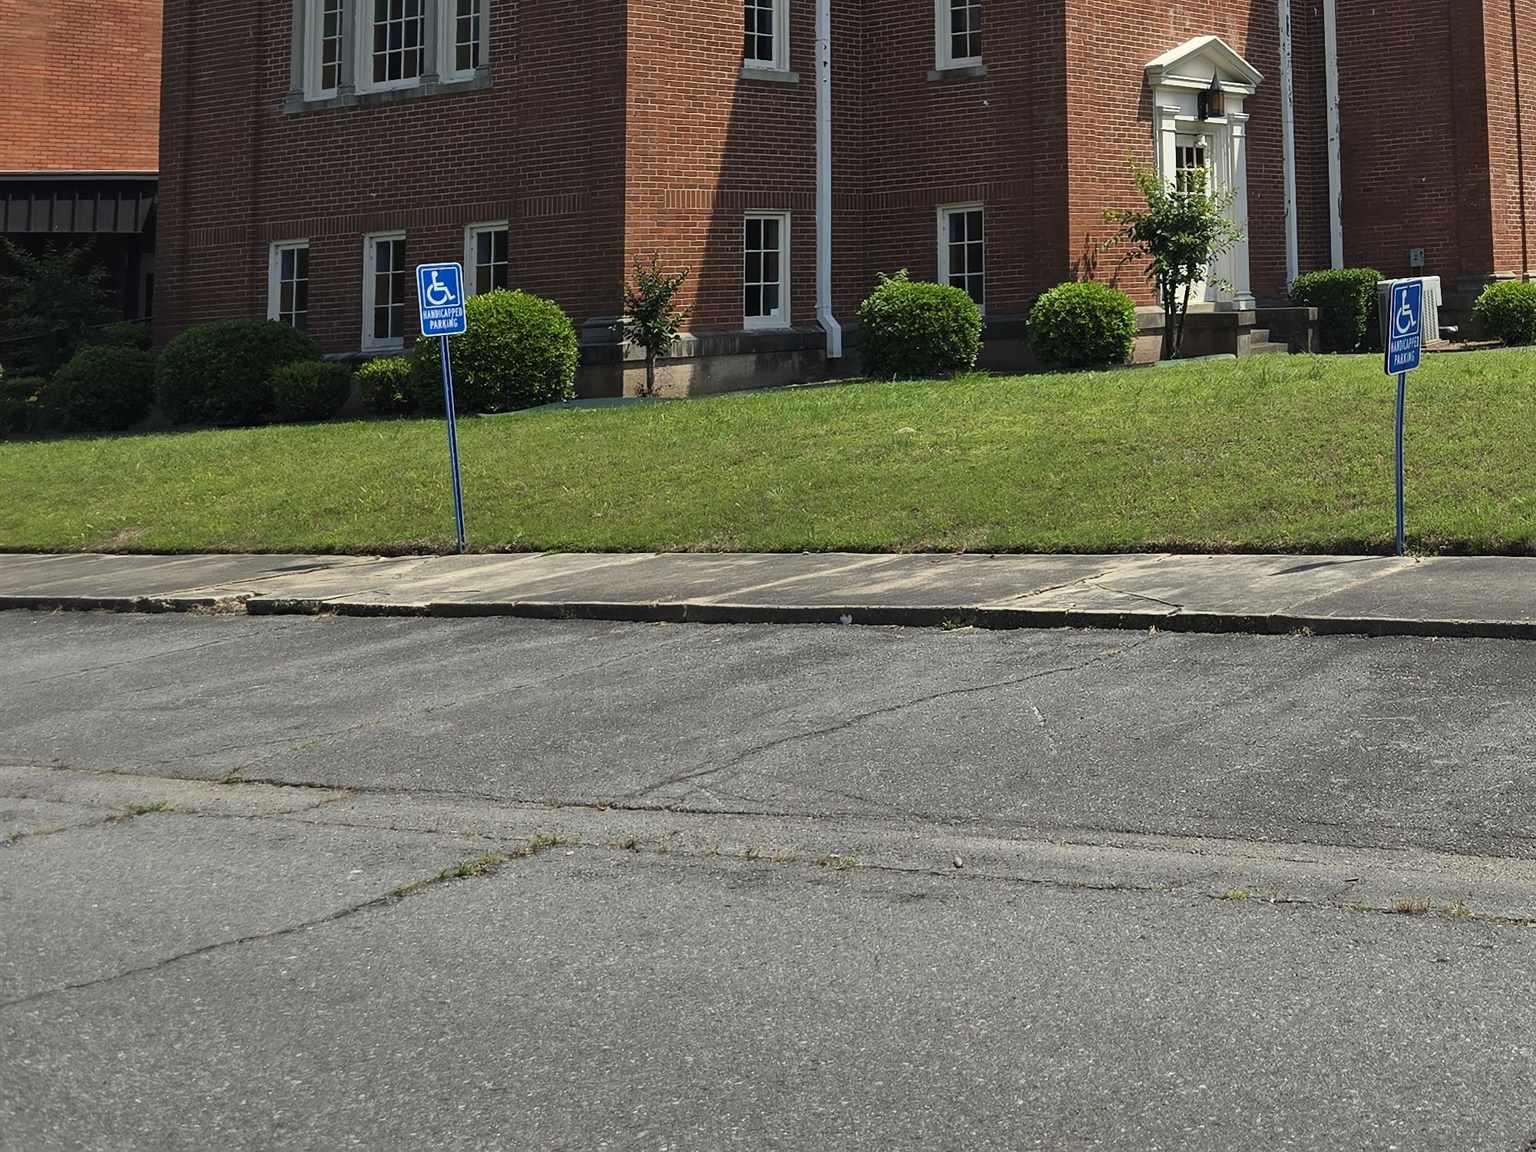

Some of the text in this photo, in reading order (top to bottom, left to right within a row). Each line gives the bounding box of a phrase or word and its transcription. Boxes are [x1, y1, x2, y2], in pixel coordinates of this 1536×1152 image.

[423, 308, 462, 319] HANDICAPPED
[430, 319, 458, 329] PARKING
[1391, 336, 1419, 352] HANDICAPPED
[1394, 350, 1415, 366] PARKING
